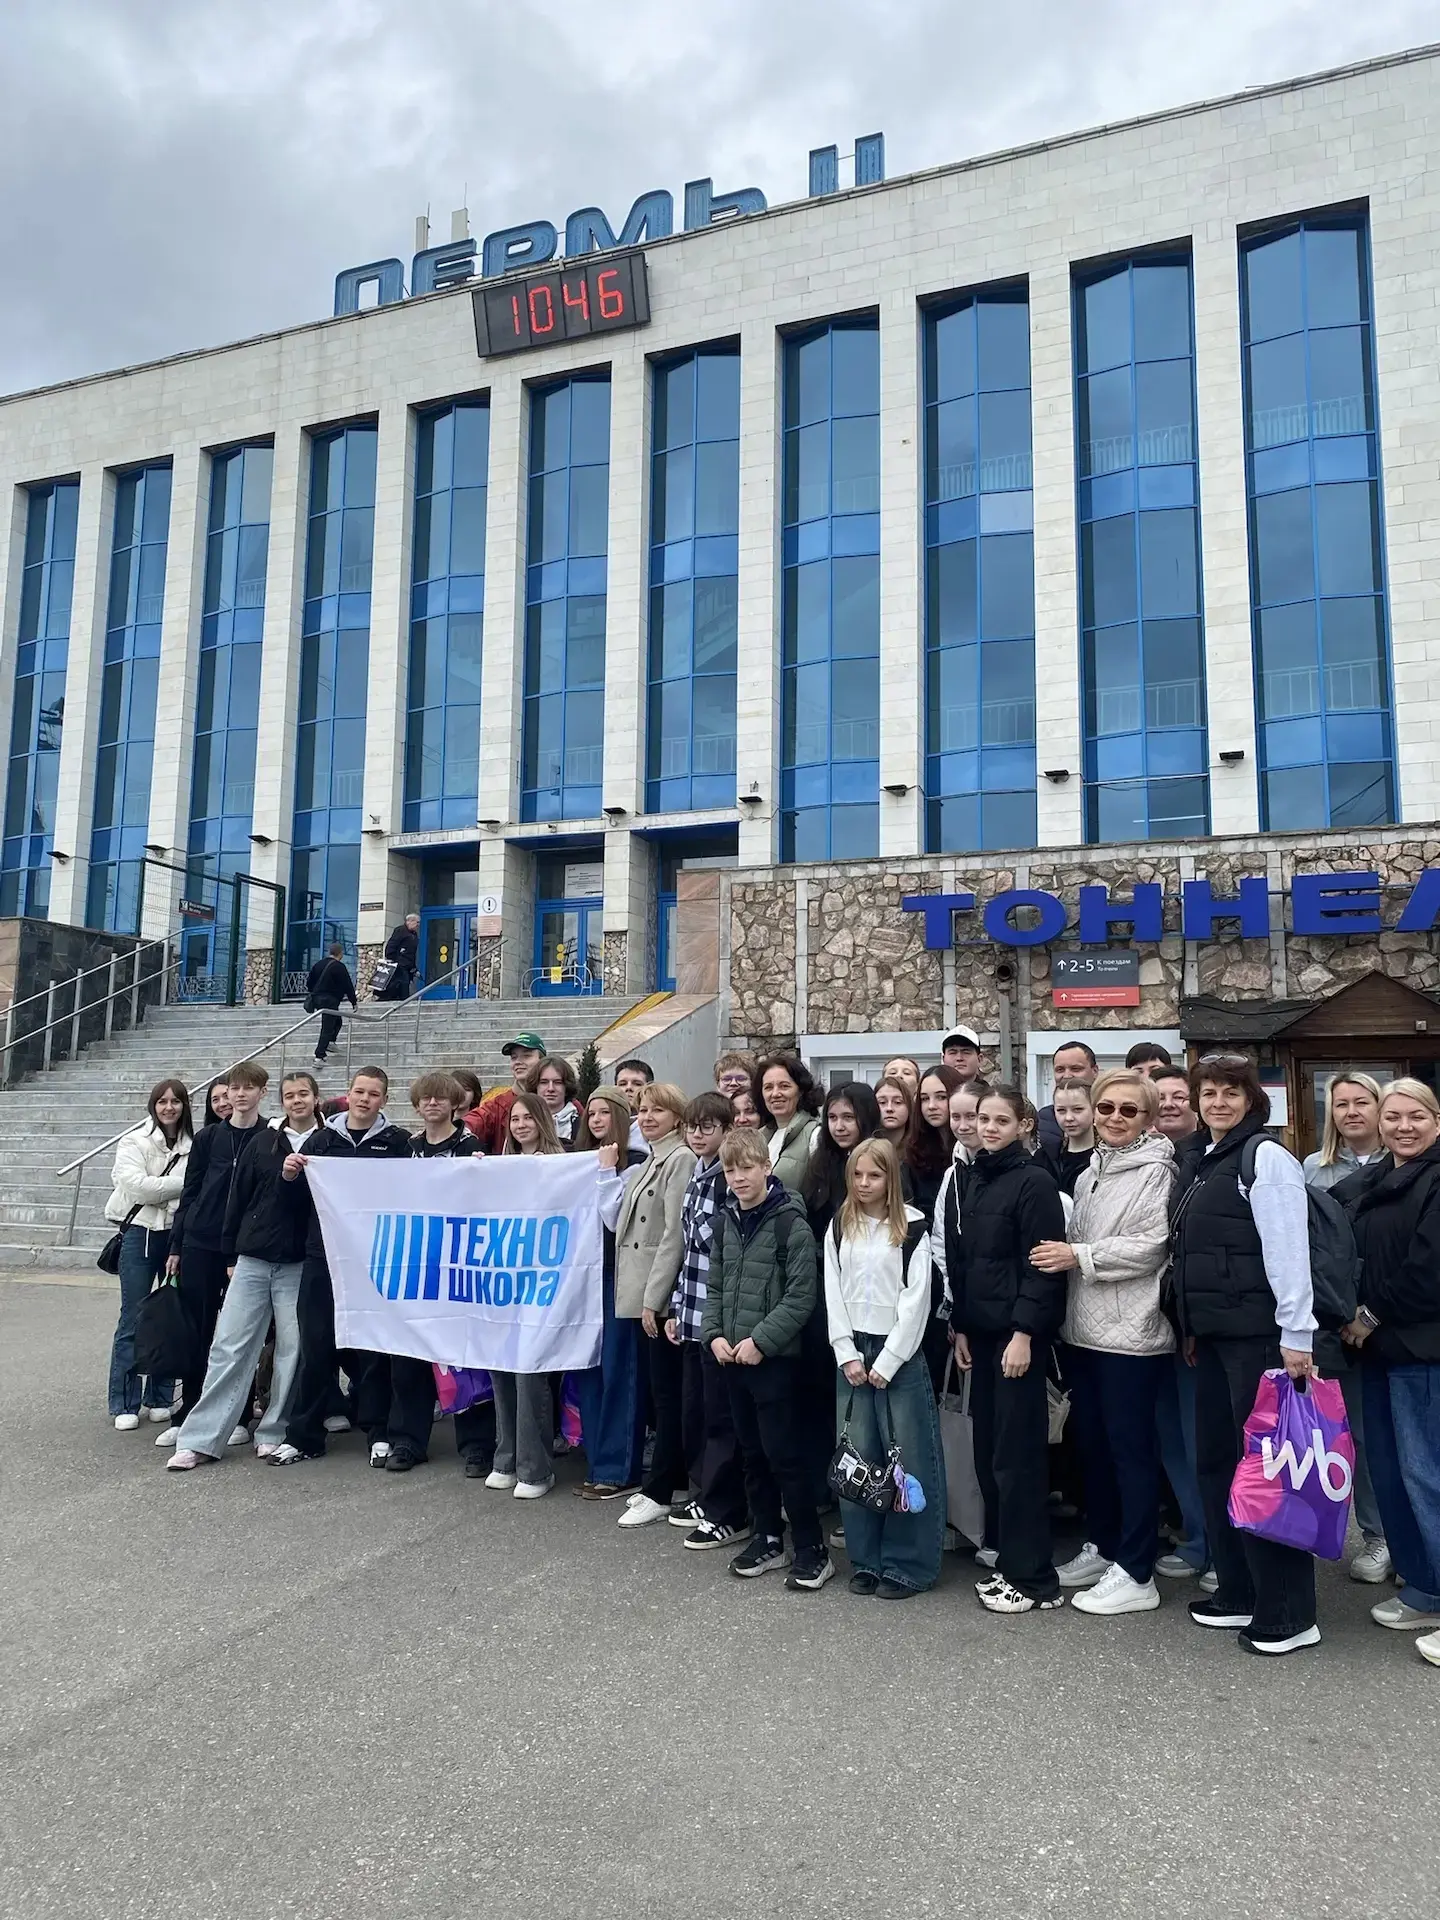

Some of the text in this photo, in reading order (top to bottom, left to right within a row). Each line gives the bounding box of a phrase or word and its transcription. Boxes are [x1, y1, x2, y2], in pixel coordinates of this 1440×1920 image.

[334, 177, 767, 316] ПЕРМЬ
[1069, 959, 1095, 972] 2-5
[446, 1215, 570, 1268] ТЕХНО
[1261, 1428, 1353, 1503] wb
